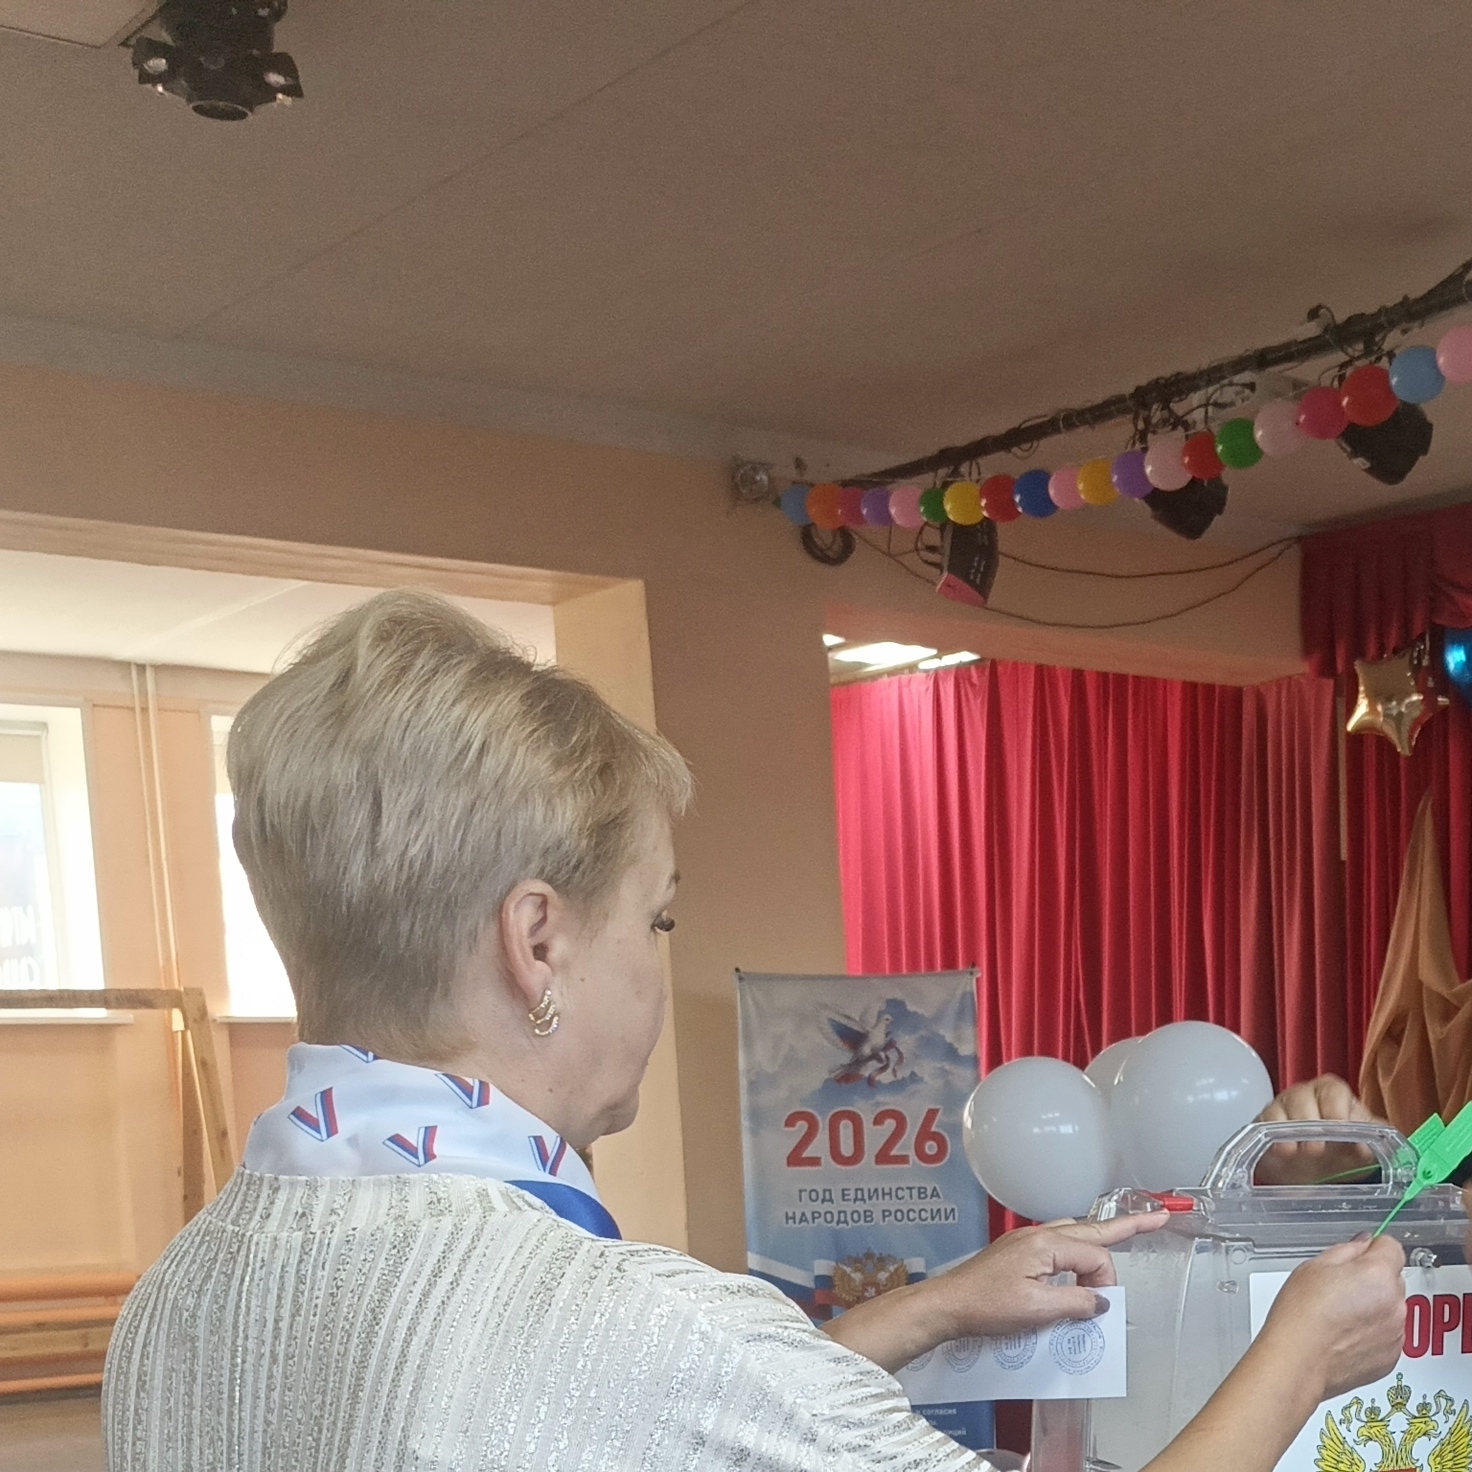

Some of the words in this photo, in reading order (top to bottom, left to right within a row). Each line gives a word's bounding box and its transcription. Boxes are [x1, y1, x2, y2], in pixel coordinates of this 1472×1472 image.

[784, 1108, 949, 1168] 2026
[798, 1188, 835, 1205] ГОД
[841, 1185, 942, 1204] ЕДИНСТВА
[785, 1209, 875, 1226] НАРОДОВ
[882, 1207, 957, 1223] РОССИИ
